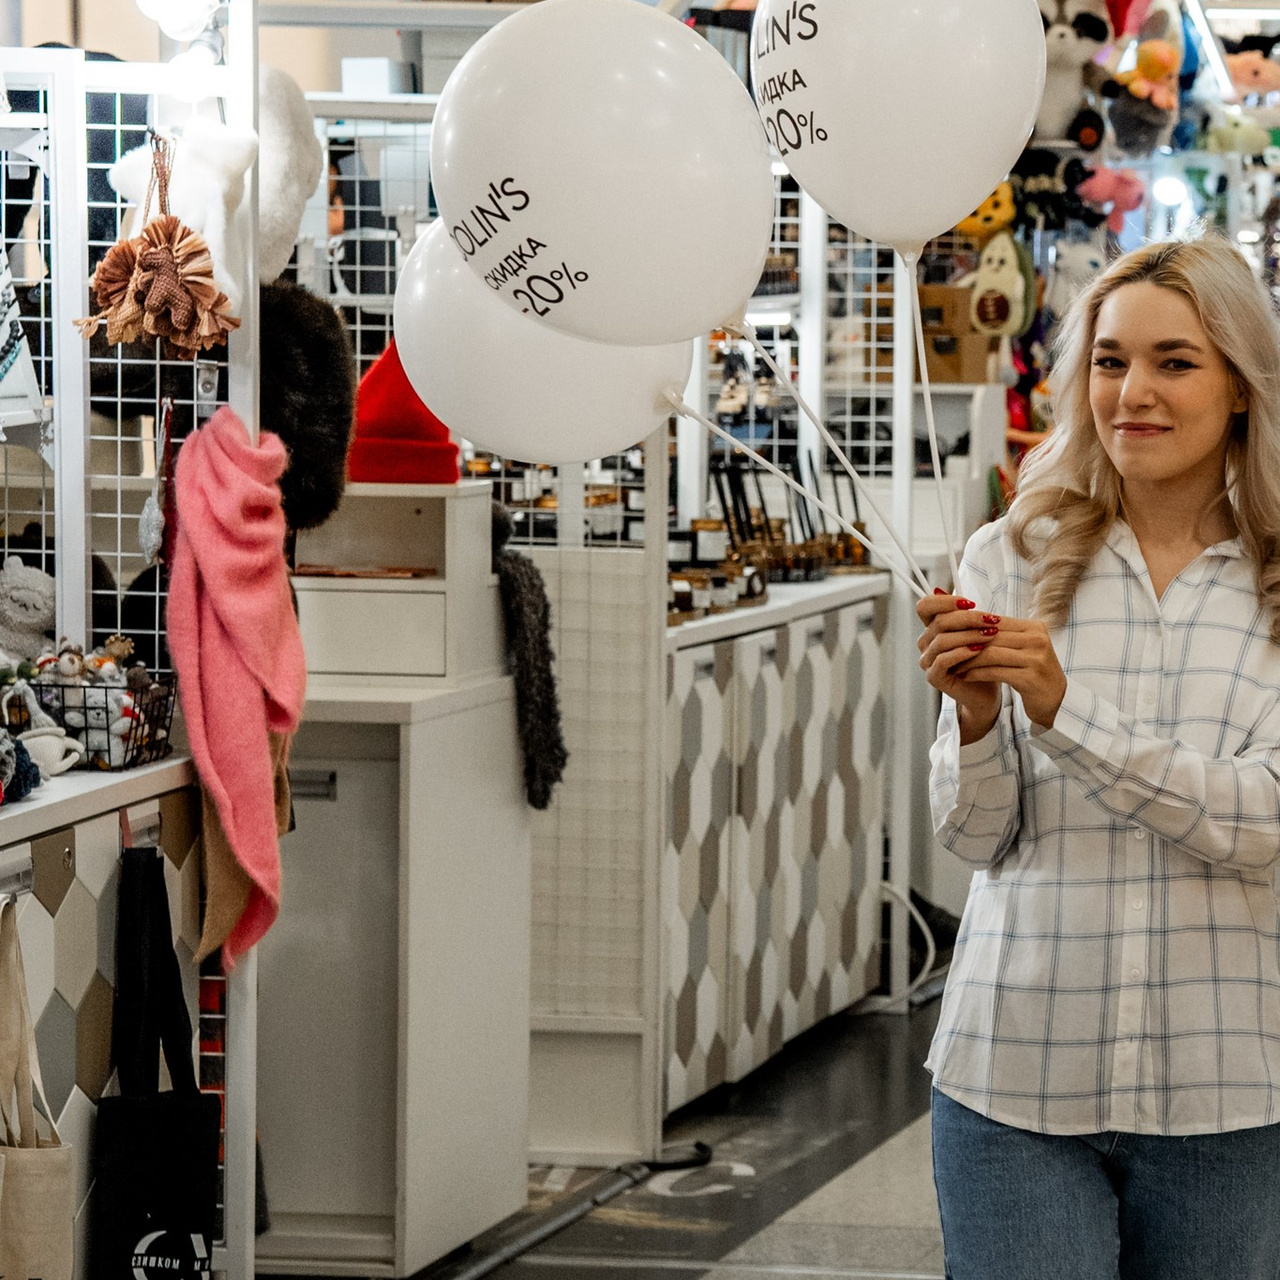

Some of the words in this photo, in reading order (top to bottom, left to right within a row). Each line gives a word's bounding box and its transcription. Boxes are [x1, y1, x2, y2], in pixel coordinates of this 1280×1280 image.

[484, 237, 548, 290] СКИДКА
[513, 262, 589, 317] -20%
[131, 1255, 180, 1270] СЛИШКОМ
